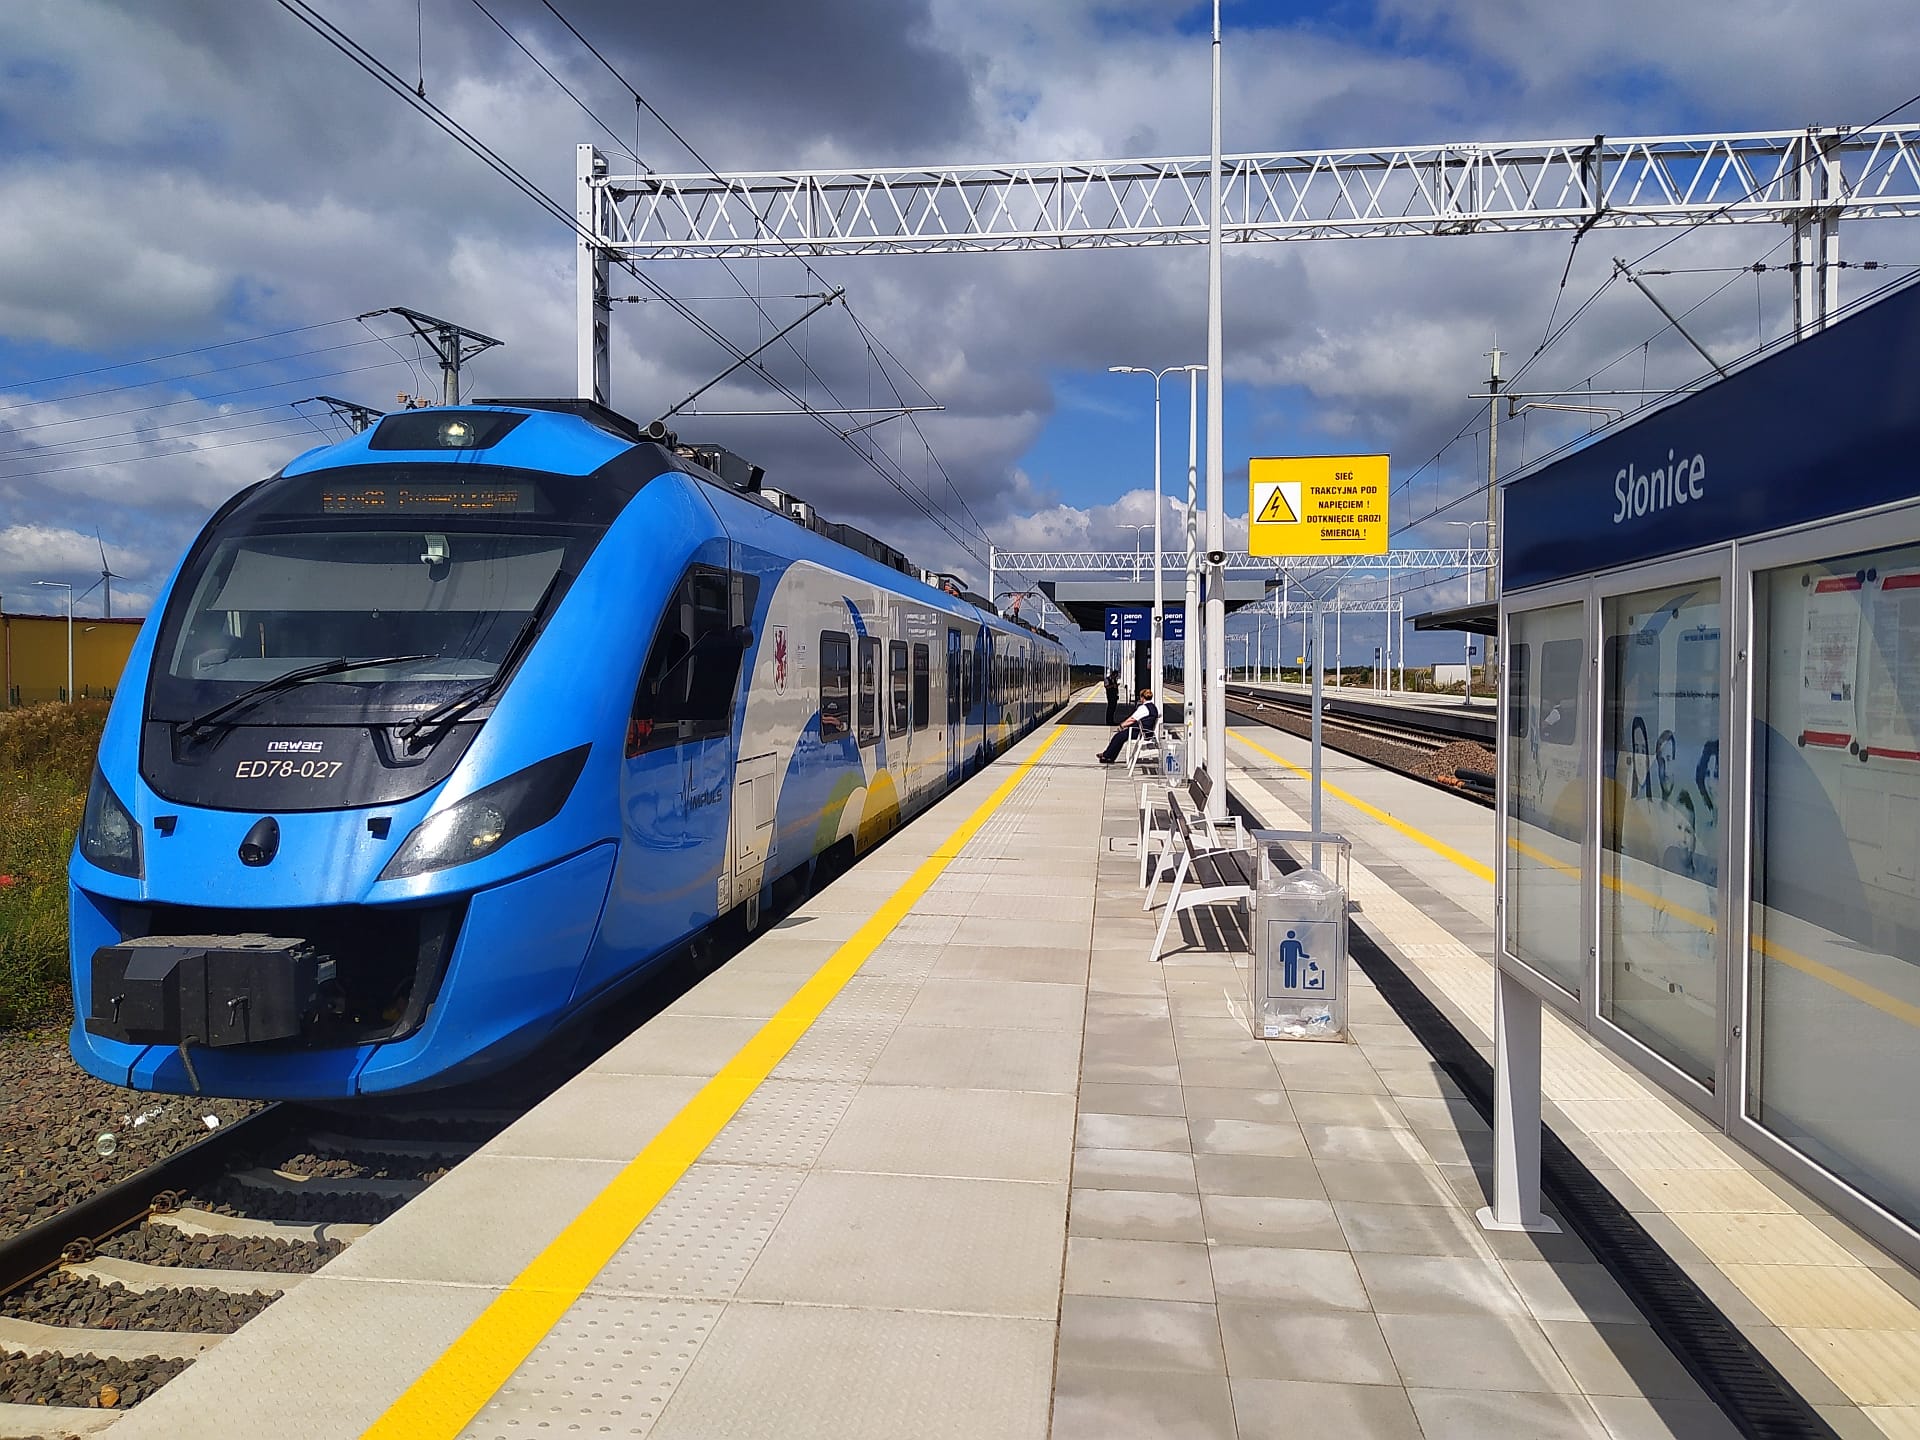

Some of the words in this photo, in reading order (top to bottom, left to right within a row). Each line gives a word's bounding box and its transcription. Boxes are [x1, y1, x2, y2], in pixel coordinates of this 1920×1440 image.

[1335, 471, 1353, 480] SIEĆ
[1360, 486, 1377, 494] POD
[1613, 448, 1705, 523] Słonice
[1318, 501, 1363, 510] NAPIĘCIEM
[1306, 515, 1355, 524] DOTKNIĘCIE
[1357, 514, 1381, 523] GROZI
[1320, 527, 1361, 538] ŚMIERCIĄ
[1110, 613, 1119, 625] 2
[1111, 628, 1119, 638] 4
[267, 740, 323, 753] newag
[235, 760, 343, 778] ED78-027
